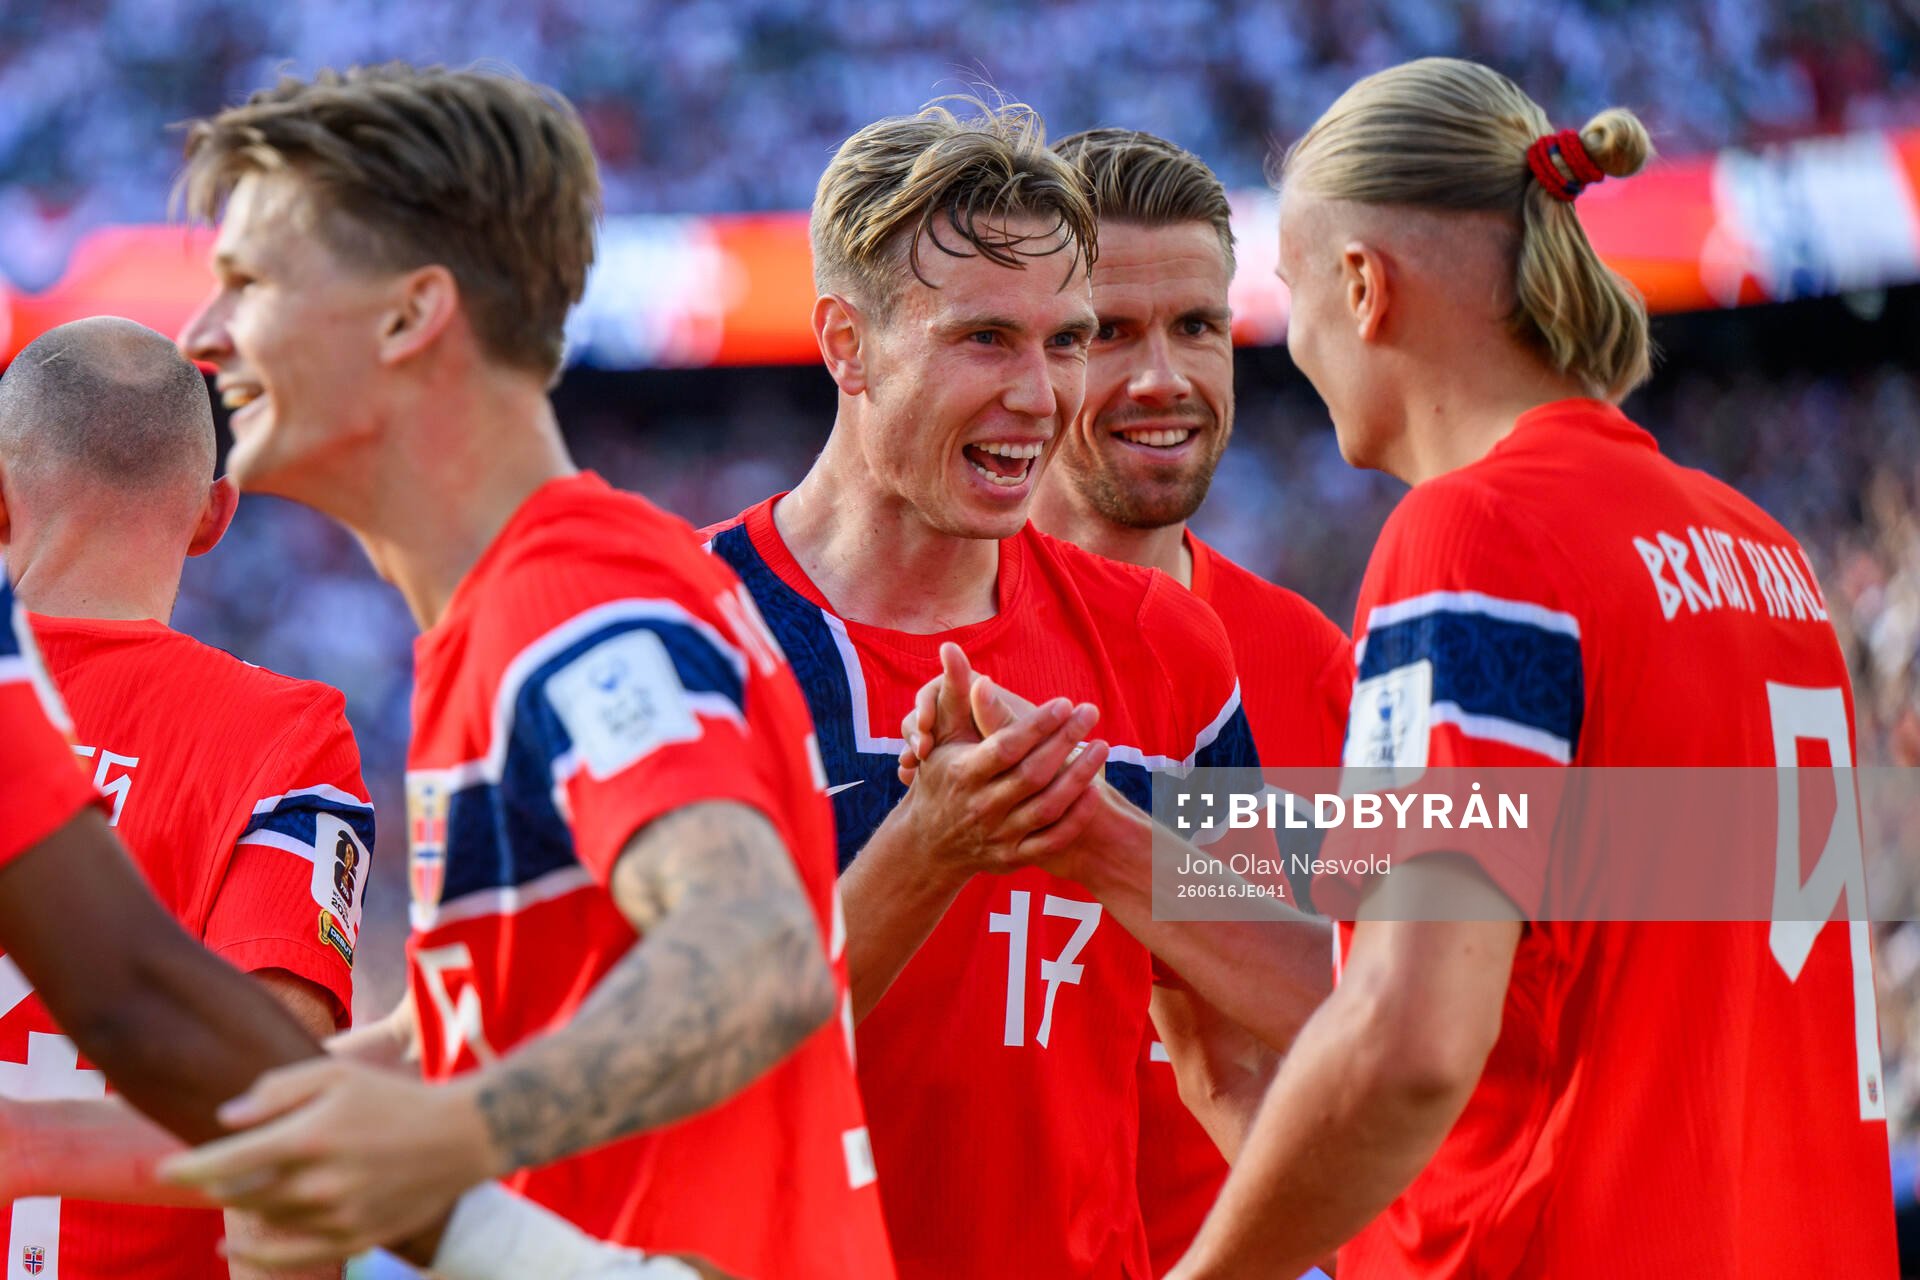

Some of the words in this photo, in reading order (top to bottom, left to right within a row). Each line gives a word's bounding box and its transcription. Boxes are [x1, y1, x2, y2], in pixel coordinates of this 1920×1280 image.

[1632, 526, 1756, 622] BRAUT
[1738, 536, 1830, 622] HAAL
[989, 889, 1104, 1050] 17
[1766, 680, 1888, 1121] 9
